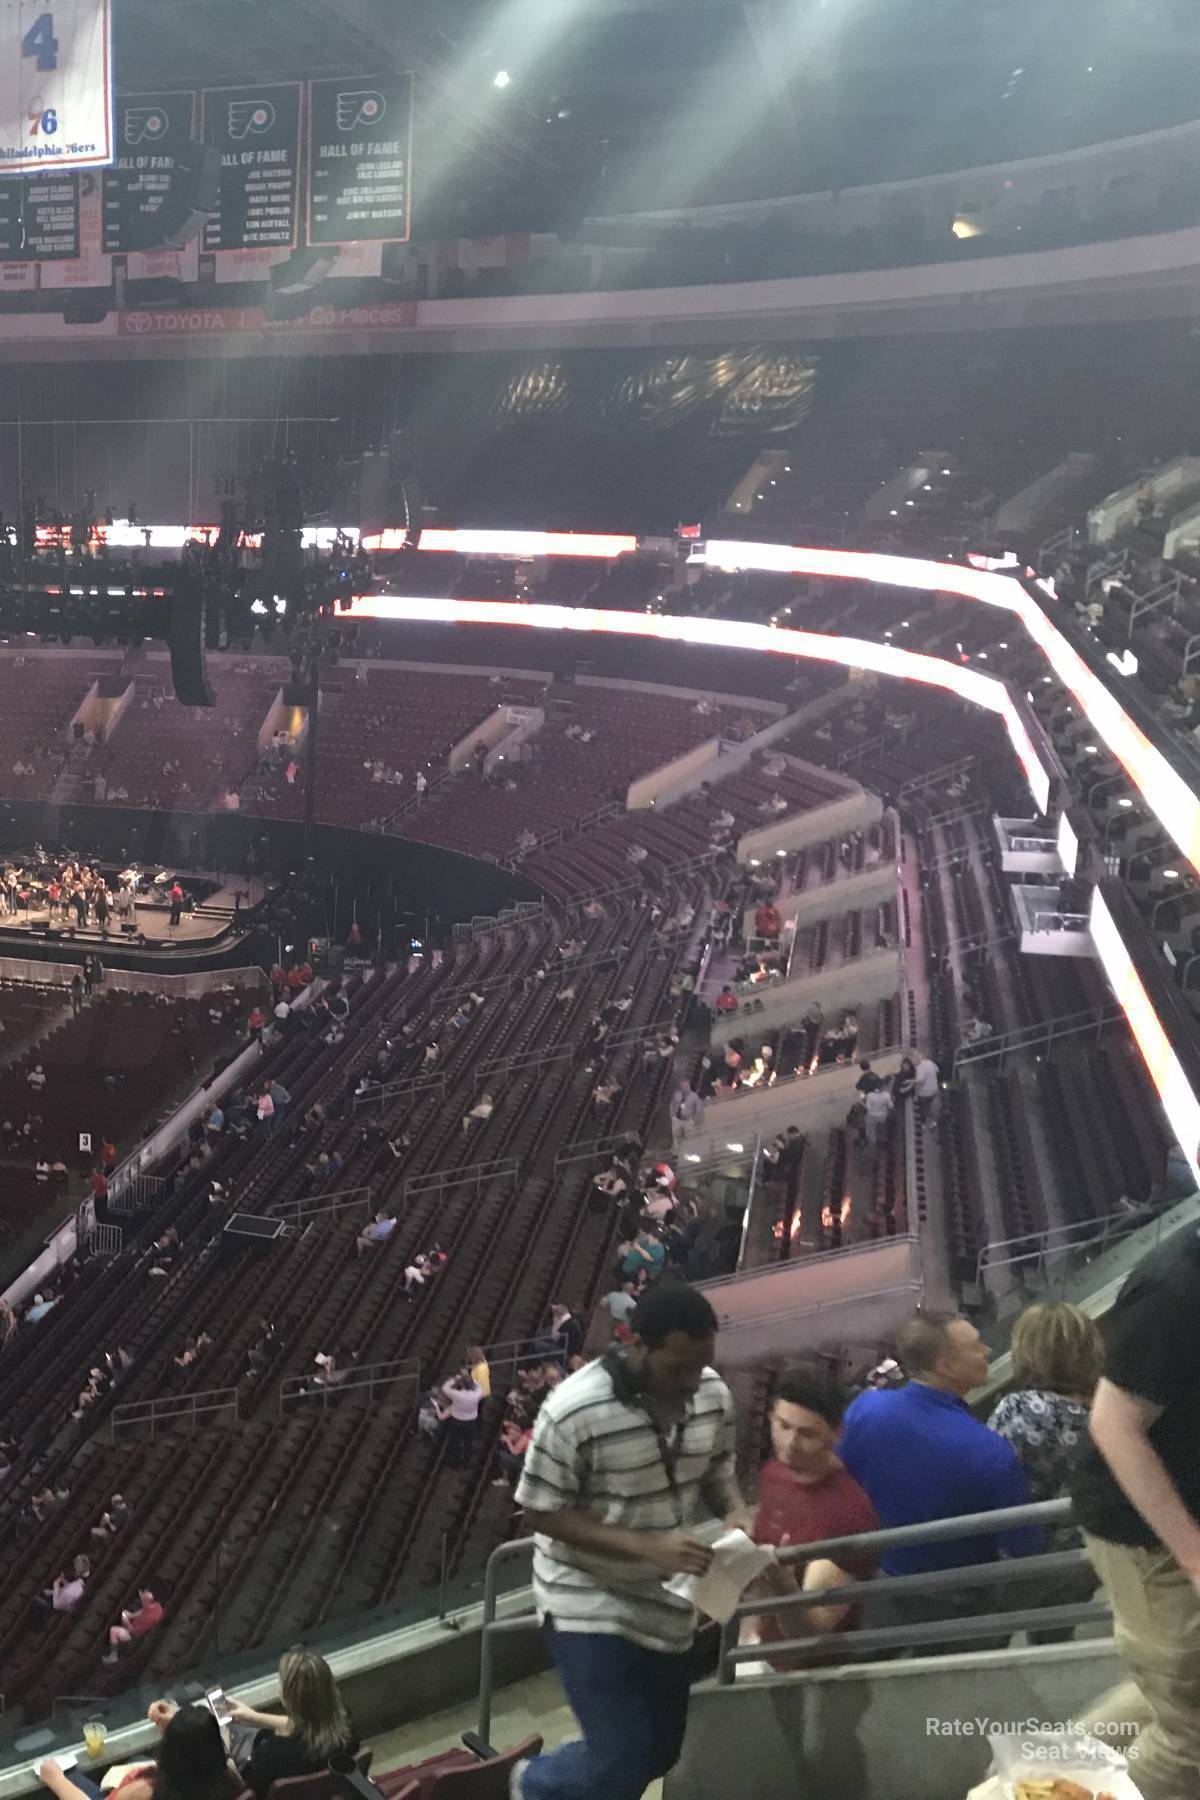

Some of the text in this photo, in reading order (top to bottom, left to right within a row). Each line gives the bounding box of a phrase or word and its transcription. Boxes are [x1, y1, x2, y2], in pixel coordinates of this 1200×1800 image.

[20, 12, 59, 73] 4
[26, 108, 58, 136] 76
[64, 142, 97, 154] 76ers
[319, 141, 400, 158] HALL OF FAME
[136, 156, 149, 169] OF
[221, 149, 288, 166] ALL OF FAME
[154, 312, 224, 330] TOYOTA
[309, 306, 337, 325] Go
[339, 306, 403, 325] Places
[82, 1135, 89, 1146] 3
